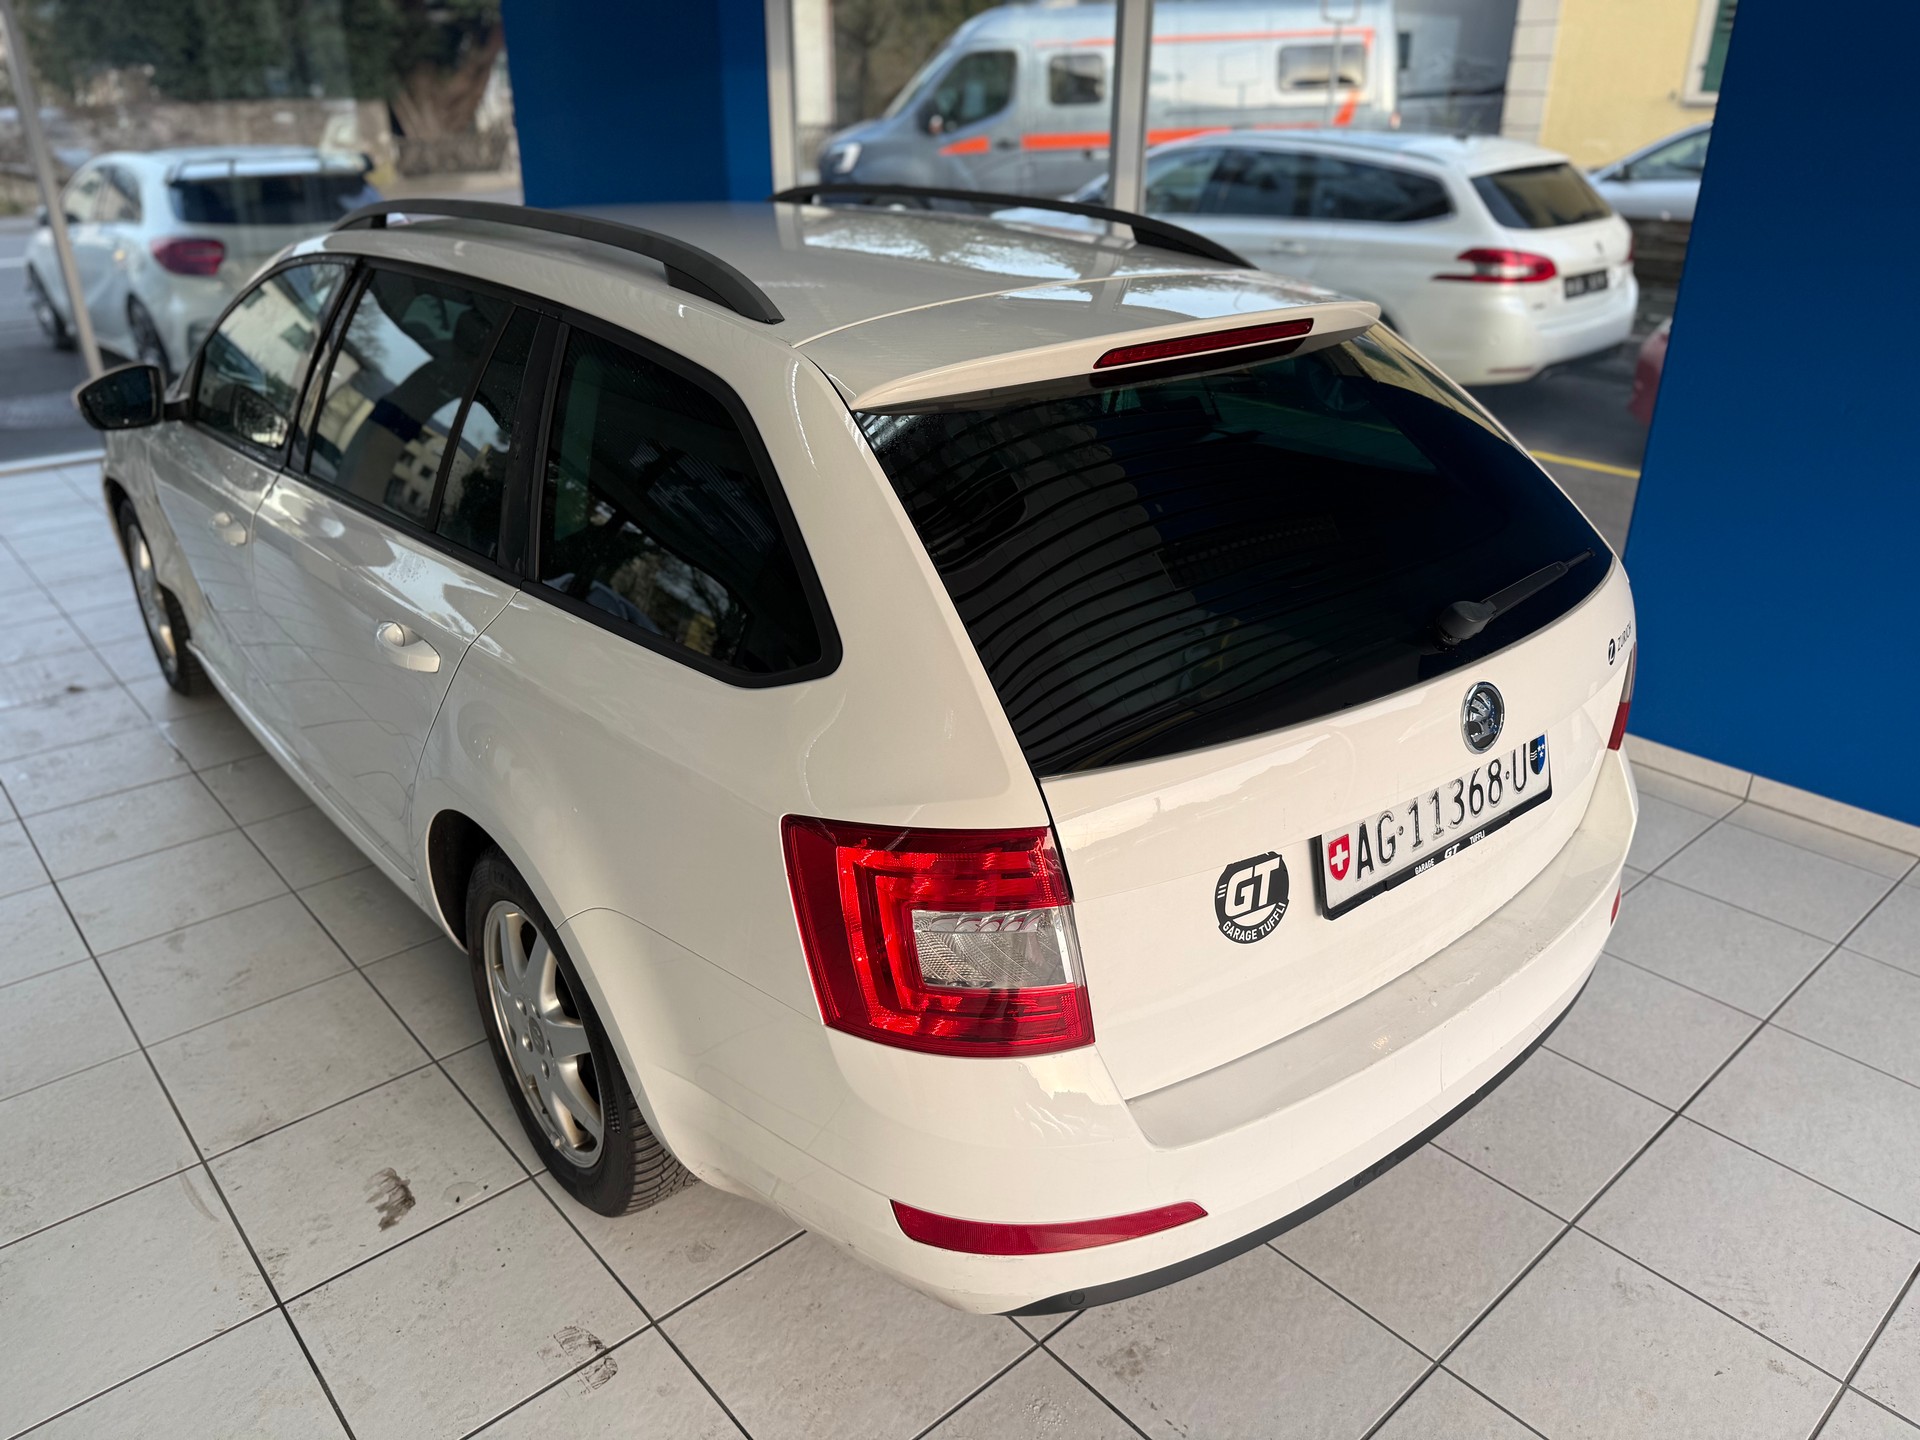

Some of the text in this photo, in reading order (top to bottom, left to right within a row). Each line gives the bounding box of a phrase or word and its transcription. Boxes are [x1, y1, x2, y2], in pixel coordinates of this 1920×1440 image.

[1414, 830, 1486, 875] GARAGE GT TUFFLI
[1225, 856, 1280, 917] GT
[1222, 902, 1287, 941] GARAGE TUFFLI
